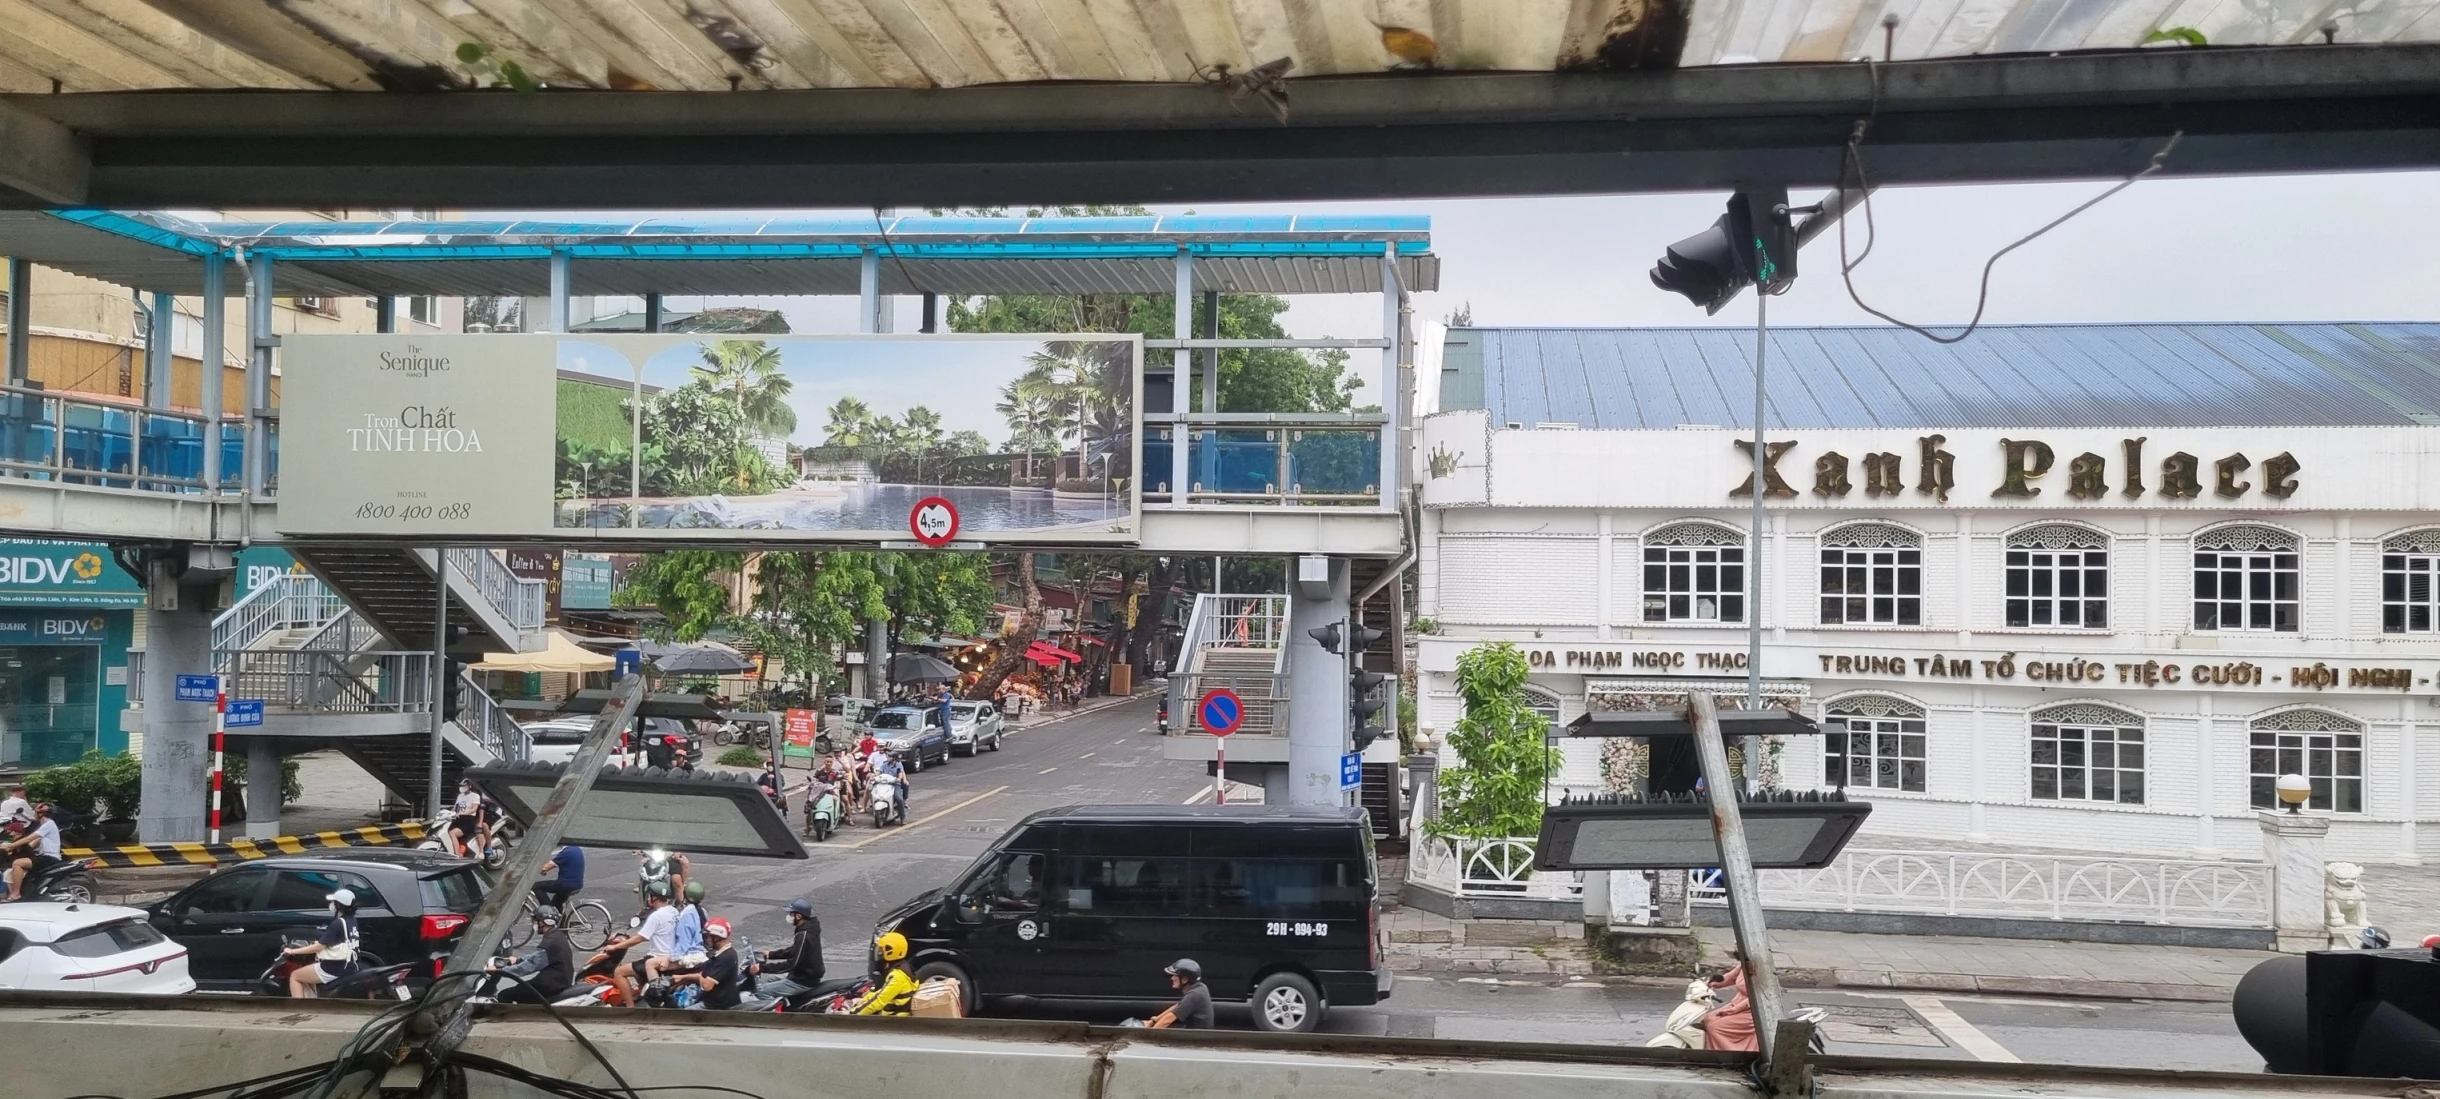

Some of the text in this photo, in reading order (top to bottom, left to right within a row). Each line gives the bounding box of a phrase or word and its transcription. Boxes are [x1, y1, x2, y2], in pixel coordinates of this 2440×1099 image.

[408, 344, 423, 354] The
[379, 351, 450, 378] Senique
[364, 406, 456, 431] Trọn Chất
[346, 428, 484, 453] TINH HOA
[1728, 432, 2301, 504] Xanh Palace
[397, 491, 428, 499] HOTLINE
[353, 501, 472, 522] 1800 400 088
[43, 619, 90, 635] BIDV
[1566, 651, 1622, 671] PHẠM
[1633, 652, 1685, 673] NGỌC
[1696, 652, 1750, 673] THẠC
[1818, 654, 1906, 676] TRUNG
[1913, 653, 1972, 678] TÂM
[1980, 651, 2015, 679] TỔ
[2025, 656, 2105, 682] CHỨC
[2115, 659, 2181, 688] TIỆC
[2291, 662, 2339, 691] HỘI
[2348, 667, 2412, 692] NGHỊ
